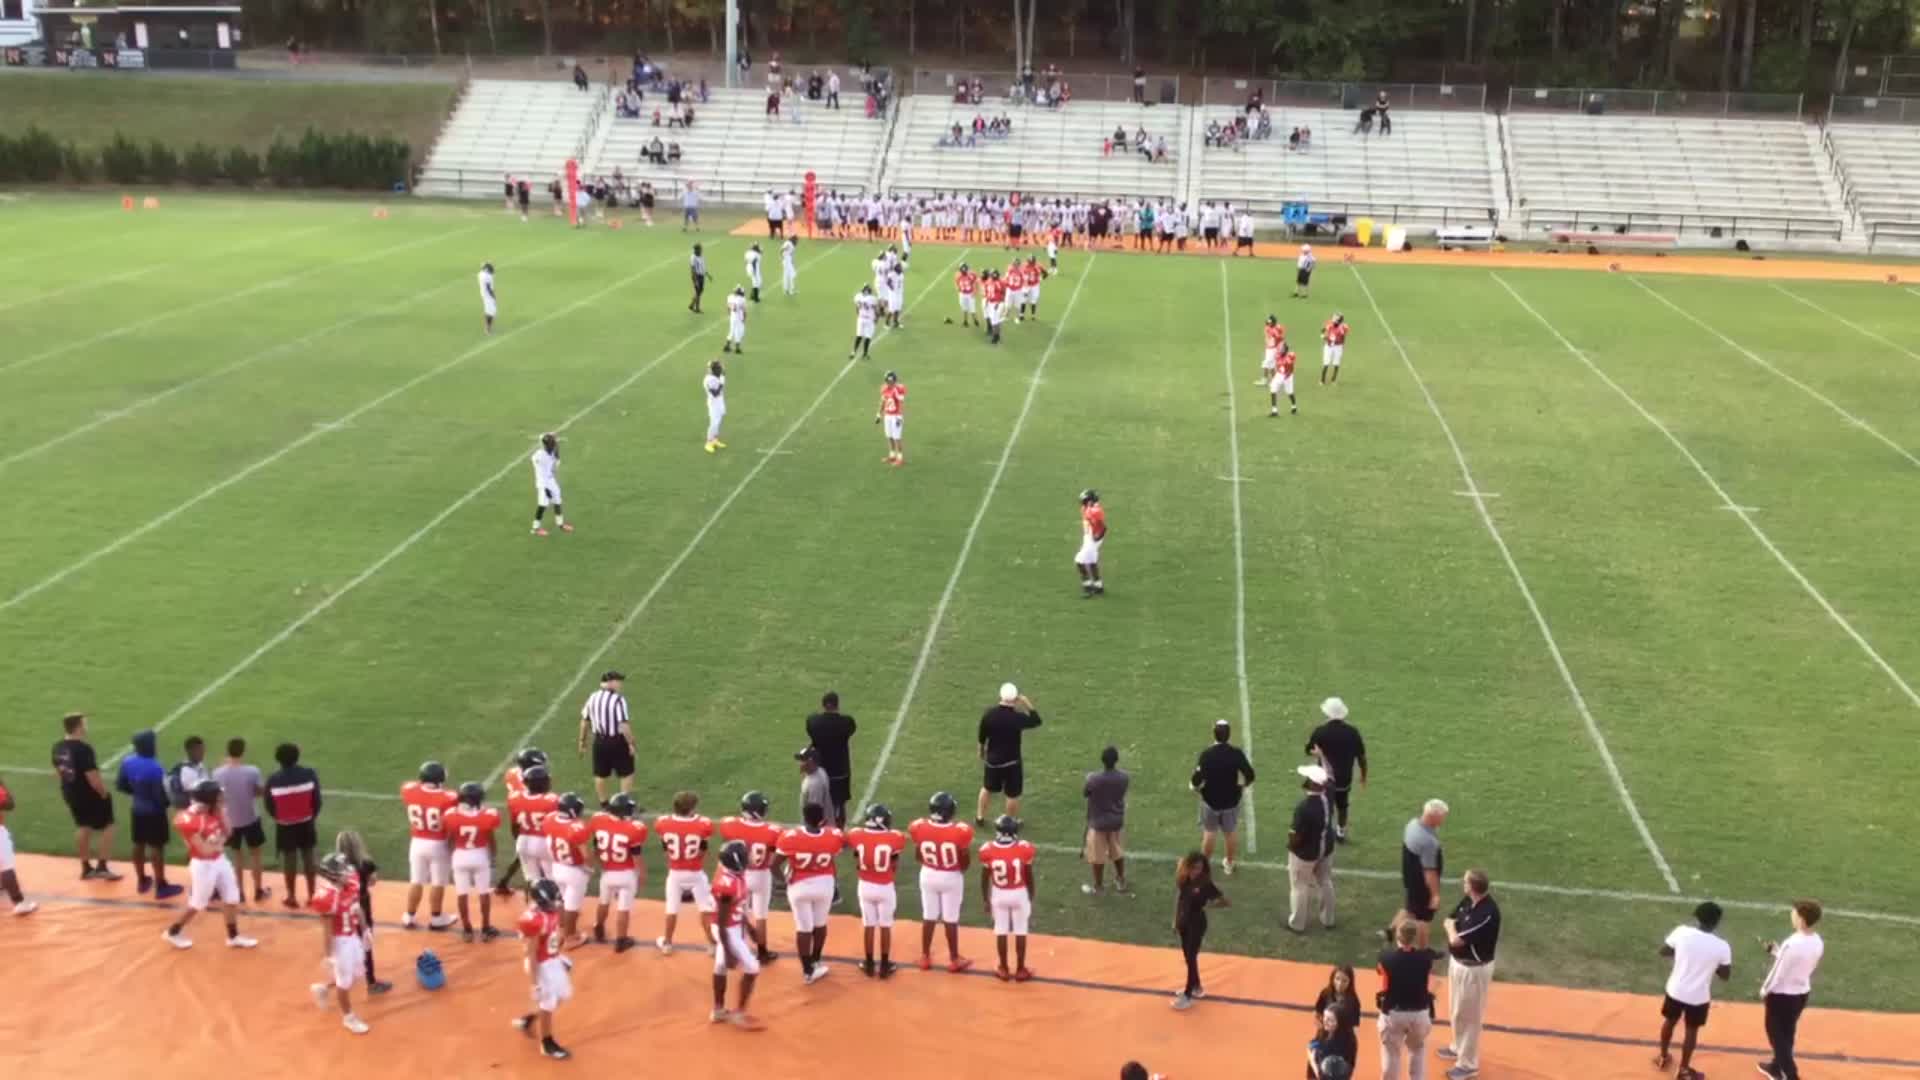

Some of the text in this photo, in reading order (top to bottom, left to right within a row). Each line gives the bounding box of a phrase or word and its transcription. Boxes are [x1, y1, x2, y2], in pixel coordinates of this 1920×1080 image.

[459, 825, 478, 848] 7
[856, 843, 892, 872] 10
[920, 841, 957, 868] 60
[991, 858, 1021, 885] 21
